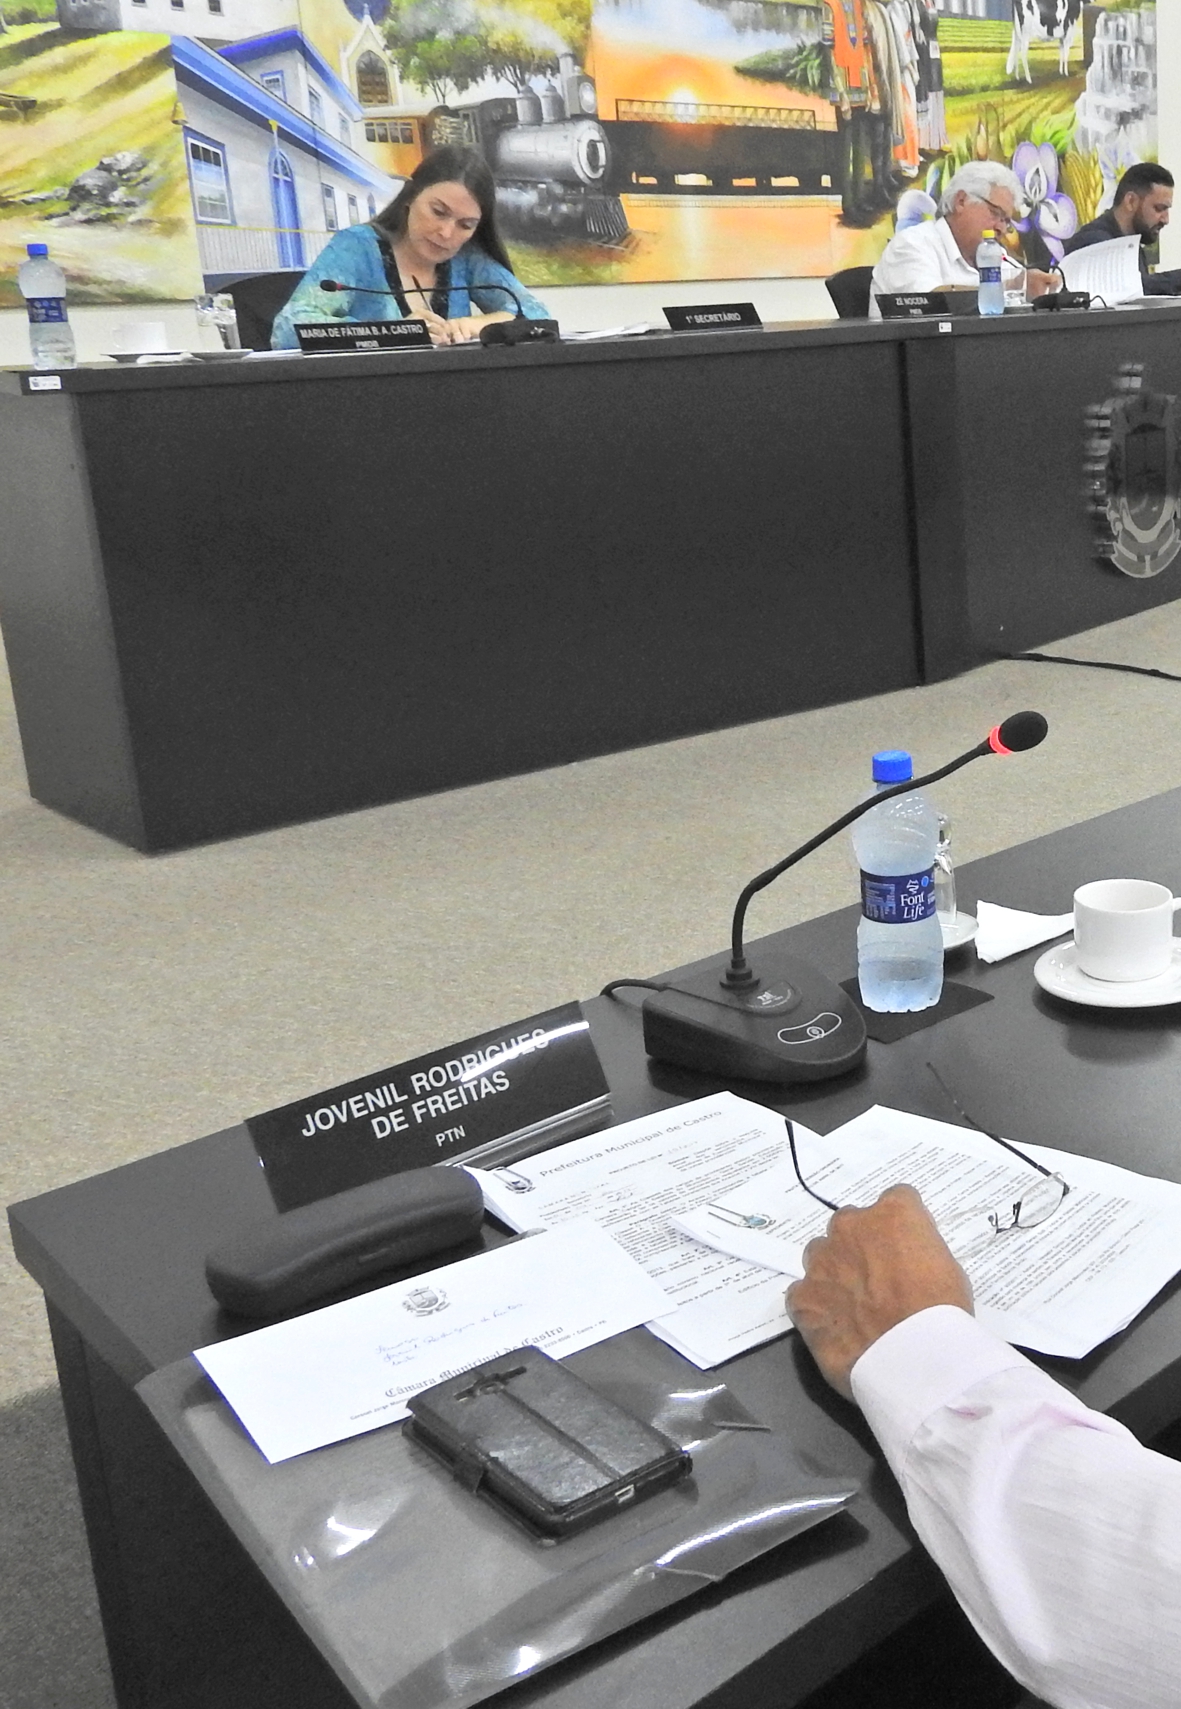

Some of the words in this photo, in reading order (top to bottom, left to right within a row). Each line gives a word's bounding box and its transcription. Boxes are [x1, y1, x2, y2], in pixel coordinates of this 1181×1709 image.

[694, 311, 741, 324] SECRETÁRIO
[299, 328, 329, 339] MARIA
[329, 328, 342, 338] DE
[342, 325, 372, 338] FÁTIMA
[391, 324, 423, 335] CASTRO
[900, 892, 925, 907] Font
[903, 903, 925, 920] Life
[301, 1082, 408, 1137] JOVENIL
[410, 1028, 549, 1095] RODRIGUES
[371, 1108, 409, 1139] DE
[411, 1070, 510, 1124] FREITAS
[435, 1125, 466, 1147] PTN
[539, 1152, 603, 1177] Prefeitura
[605, 1130, 664, 1154] Municipal
[665, 1124, 682, 1134] de
[683, 1111, 722, 1127] Castro
[385, 1377, 437, 1397] Câmara
[520, 1326, 564, 1347] Castro
